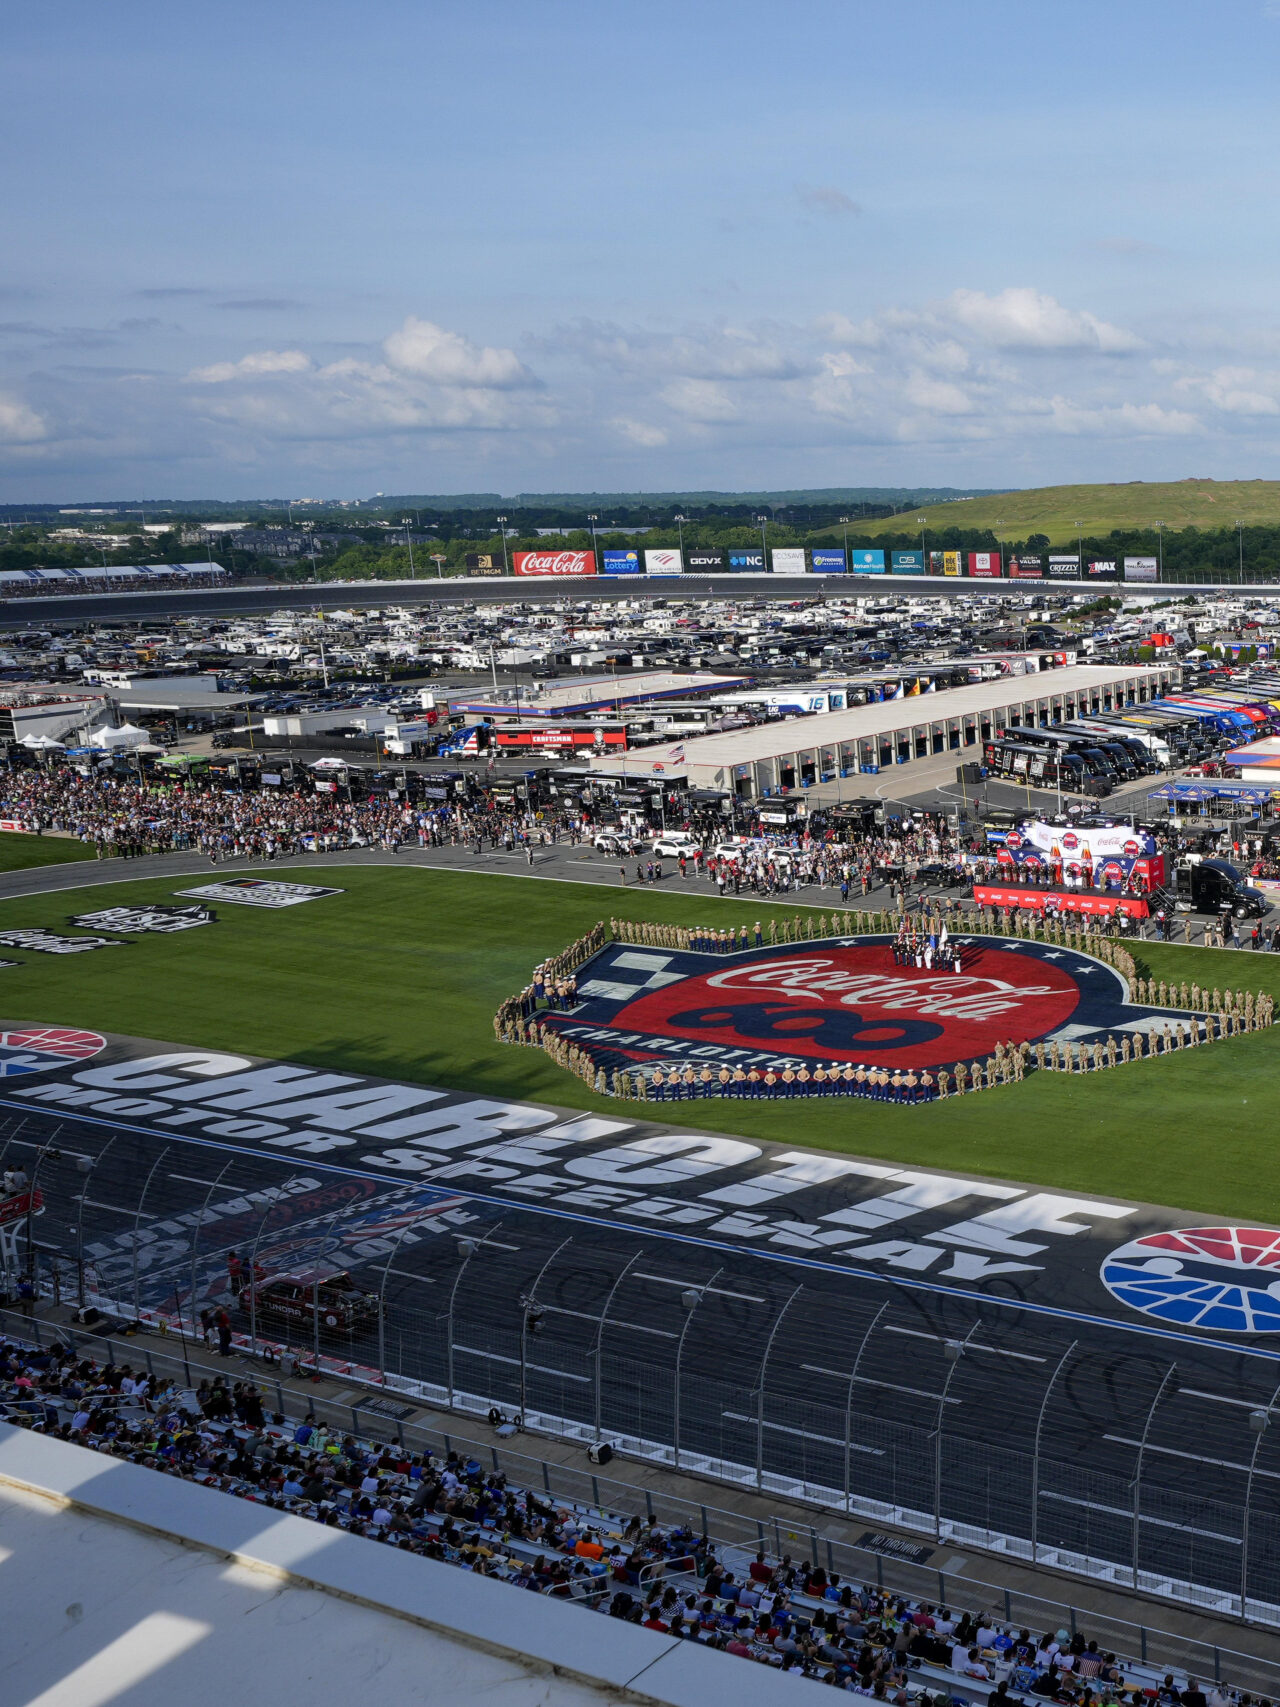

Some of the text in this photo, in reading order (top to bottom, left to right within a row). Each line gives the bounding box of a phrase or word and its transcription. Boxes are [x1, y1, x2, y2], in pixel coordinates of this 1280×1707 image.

[521, 552, 588, 574] Coca-Cola
[604, 562, 637, 571] Lottery
[690, 557, 722, 565] GOVX
[747, 556, 762, 566] NC
[1049, 564, 1079, 572] GRIZZLY
[1088, 562, 1116, 574] zMAX
[809, 697, 825, 710] 16
[1098, 837, 1120, 845] Coca-Cola
[74, 907, 214, 932] BUSCH
[706, 959, 1077, 1020] Coca-Cola
[667, 1001, 945, 1051] 600
[559, 1027, 808, 1071] CHARLOTTE
[8, 1082, 358, 1153] MOTOR
[72, 1052, 1138, 1257] CHARLOTTE
[360, 1148, 1046, 1280] SPEEDWAY
[264, 1301, 301, 1317] TUNDRA
